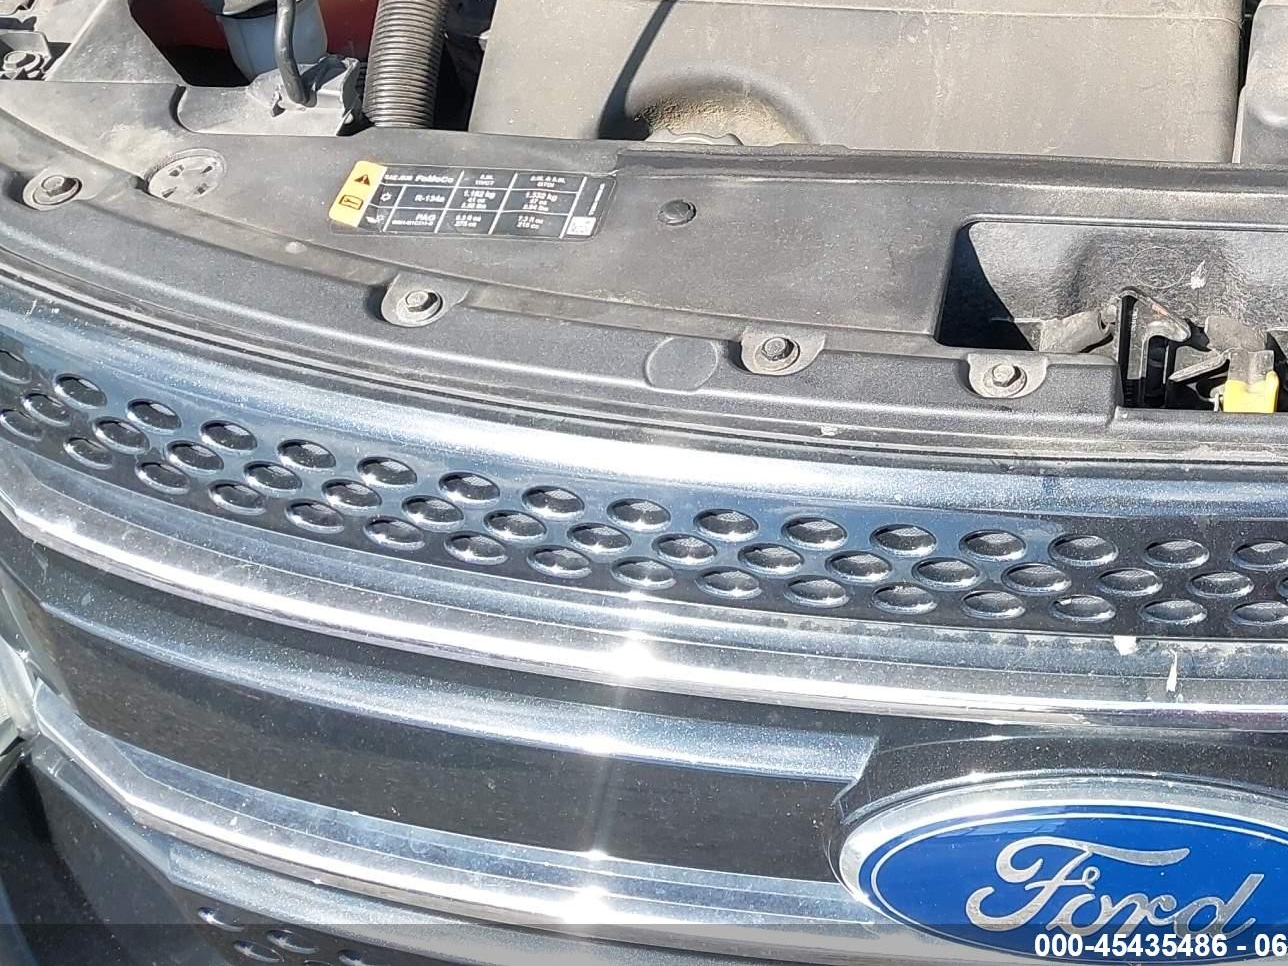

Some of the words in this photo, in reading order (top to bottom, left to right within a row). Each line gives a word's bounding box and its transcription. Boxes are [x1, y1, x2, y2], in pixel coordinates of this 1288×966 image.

[415, 175, 454, 184] FoMoCo
[414, 194, 446, 203] R-134a
[485, 190, 496, 200] kg
[546, 193, 558, 203] kg
[415, 213, 436, 221] PAG
[966, 835, 1264, 939] Ford
